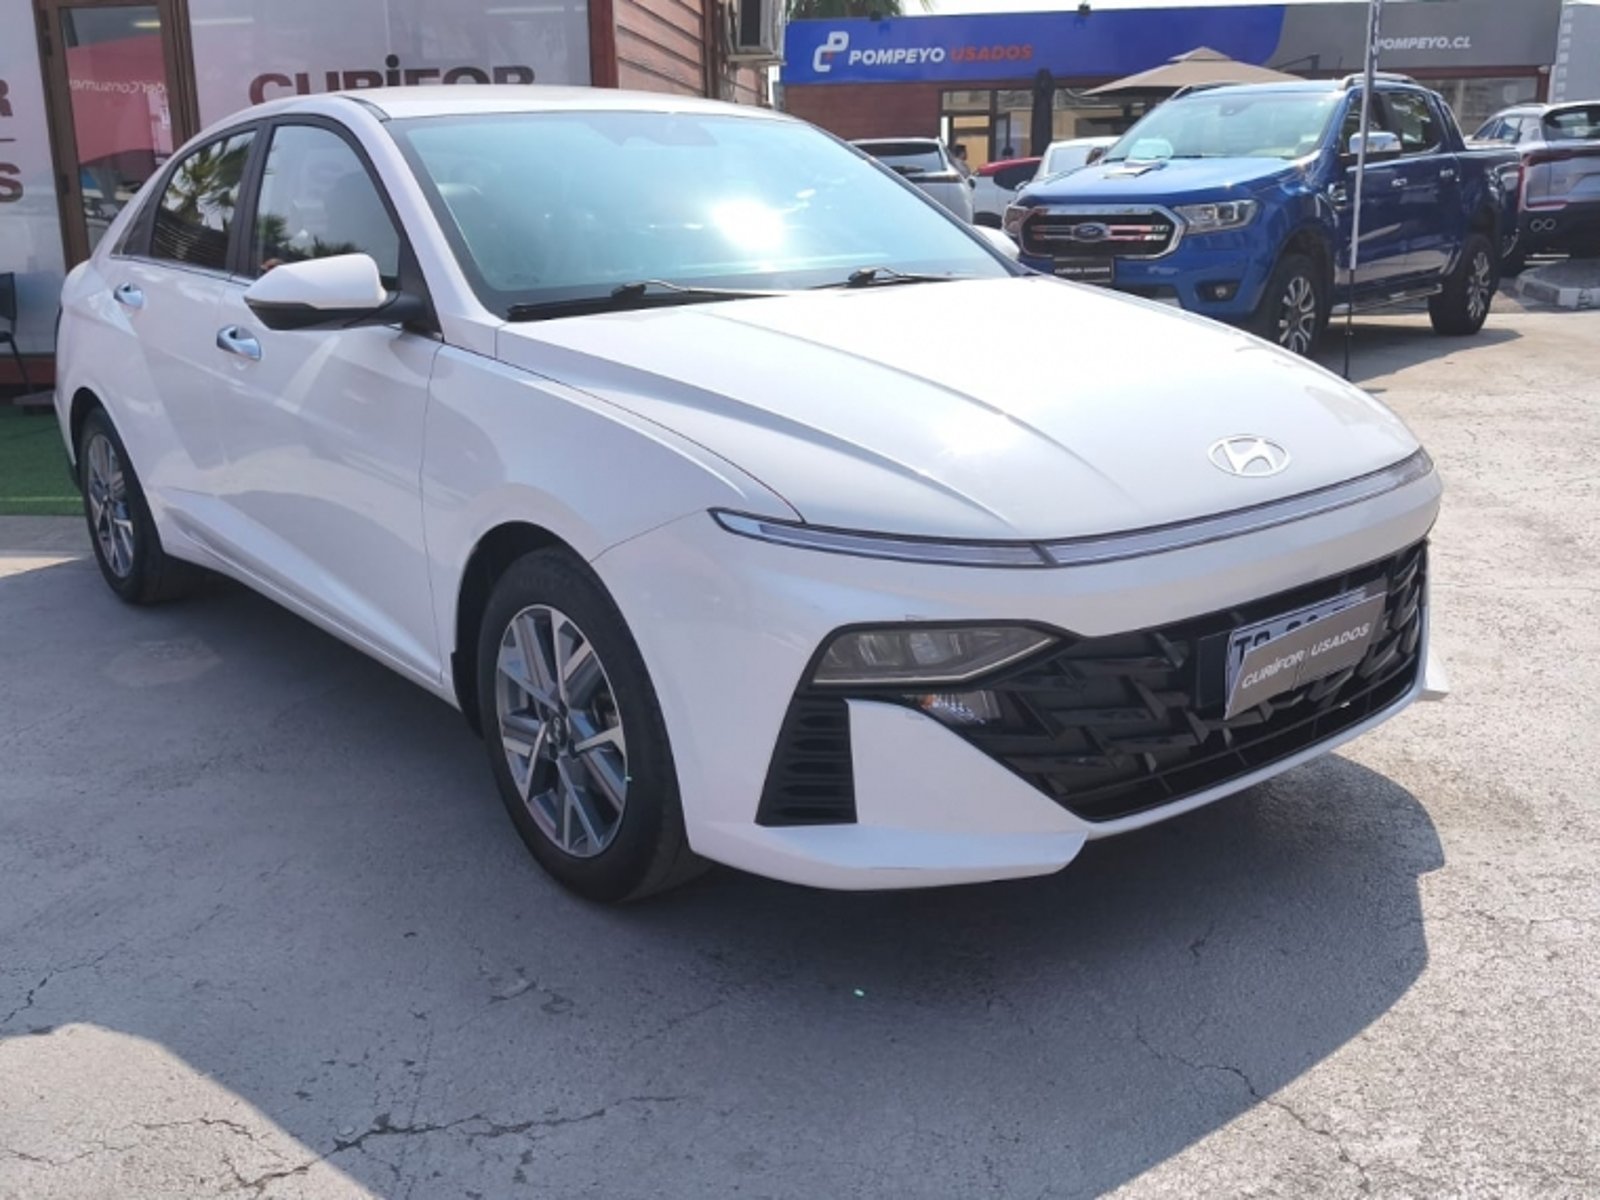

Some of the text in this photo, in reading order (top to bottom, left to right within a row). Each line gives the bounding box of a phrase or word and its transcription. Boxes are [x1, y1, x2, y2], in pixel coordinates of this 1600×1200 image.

[848, 44, 1033, 66] POMPEYO USADOS
[1311, 622, 1370, 656] USADOS
